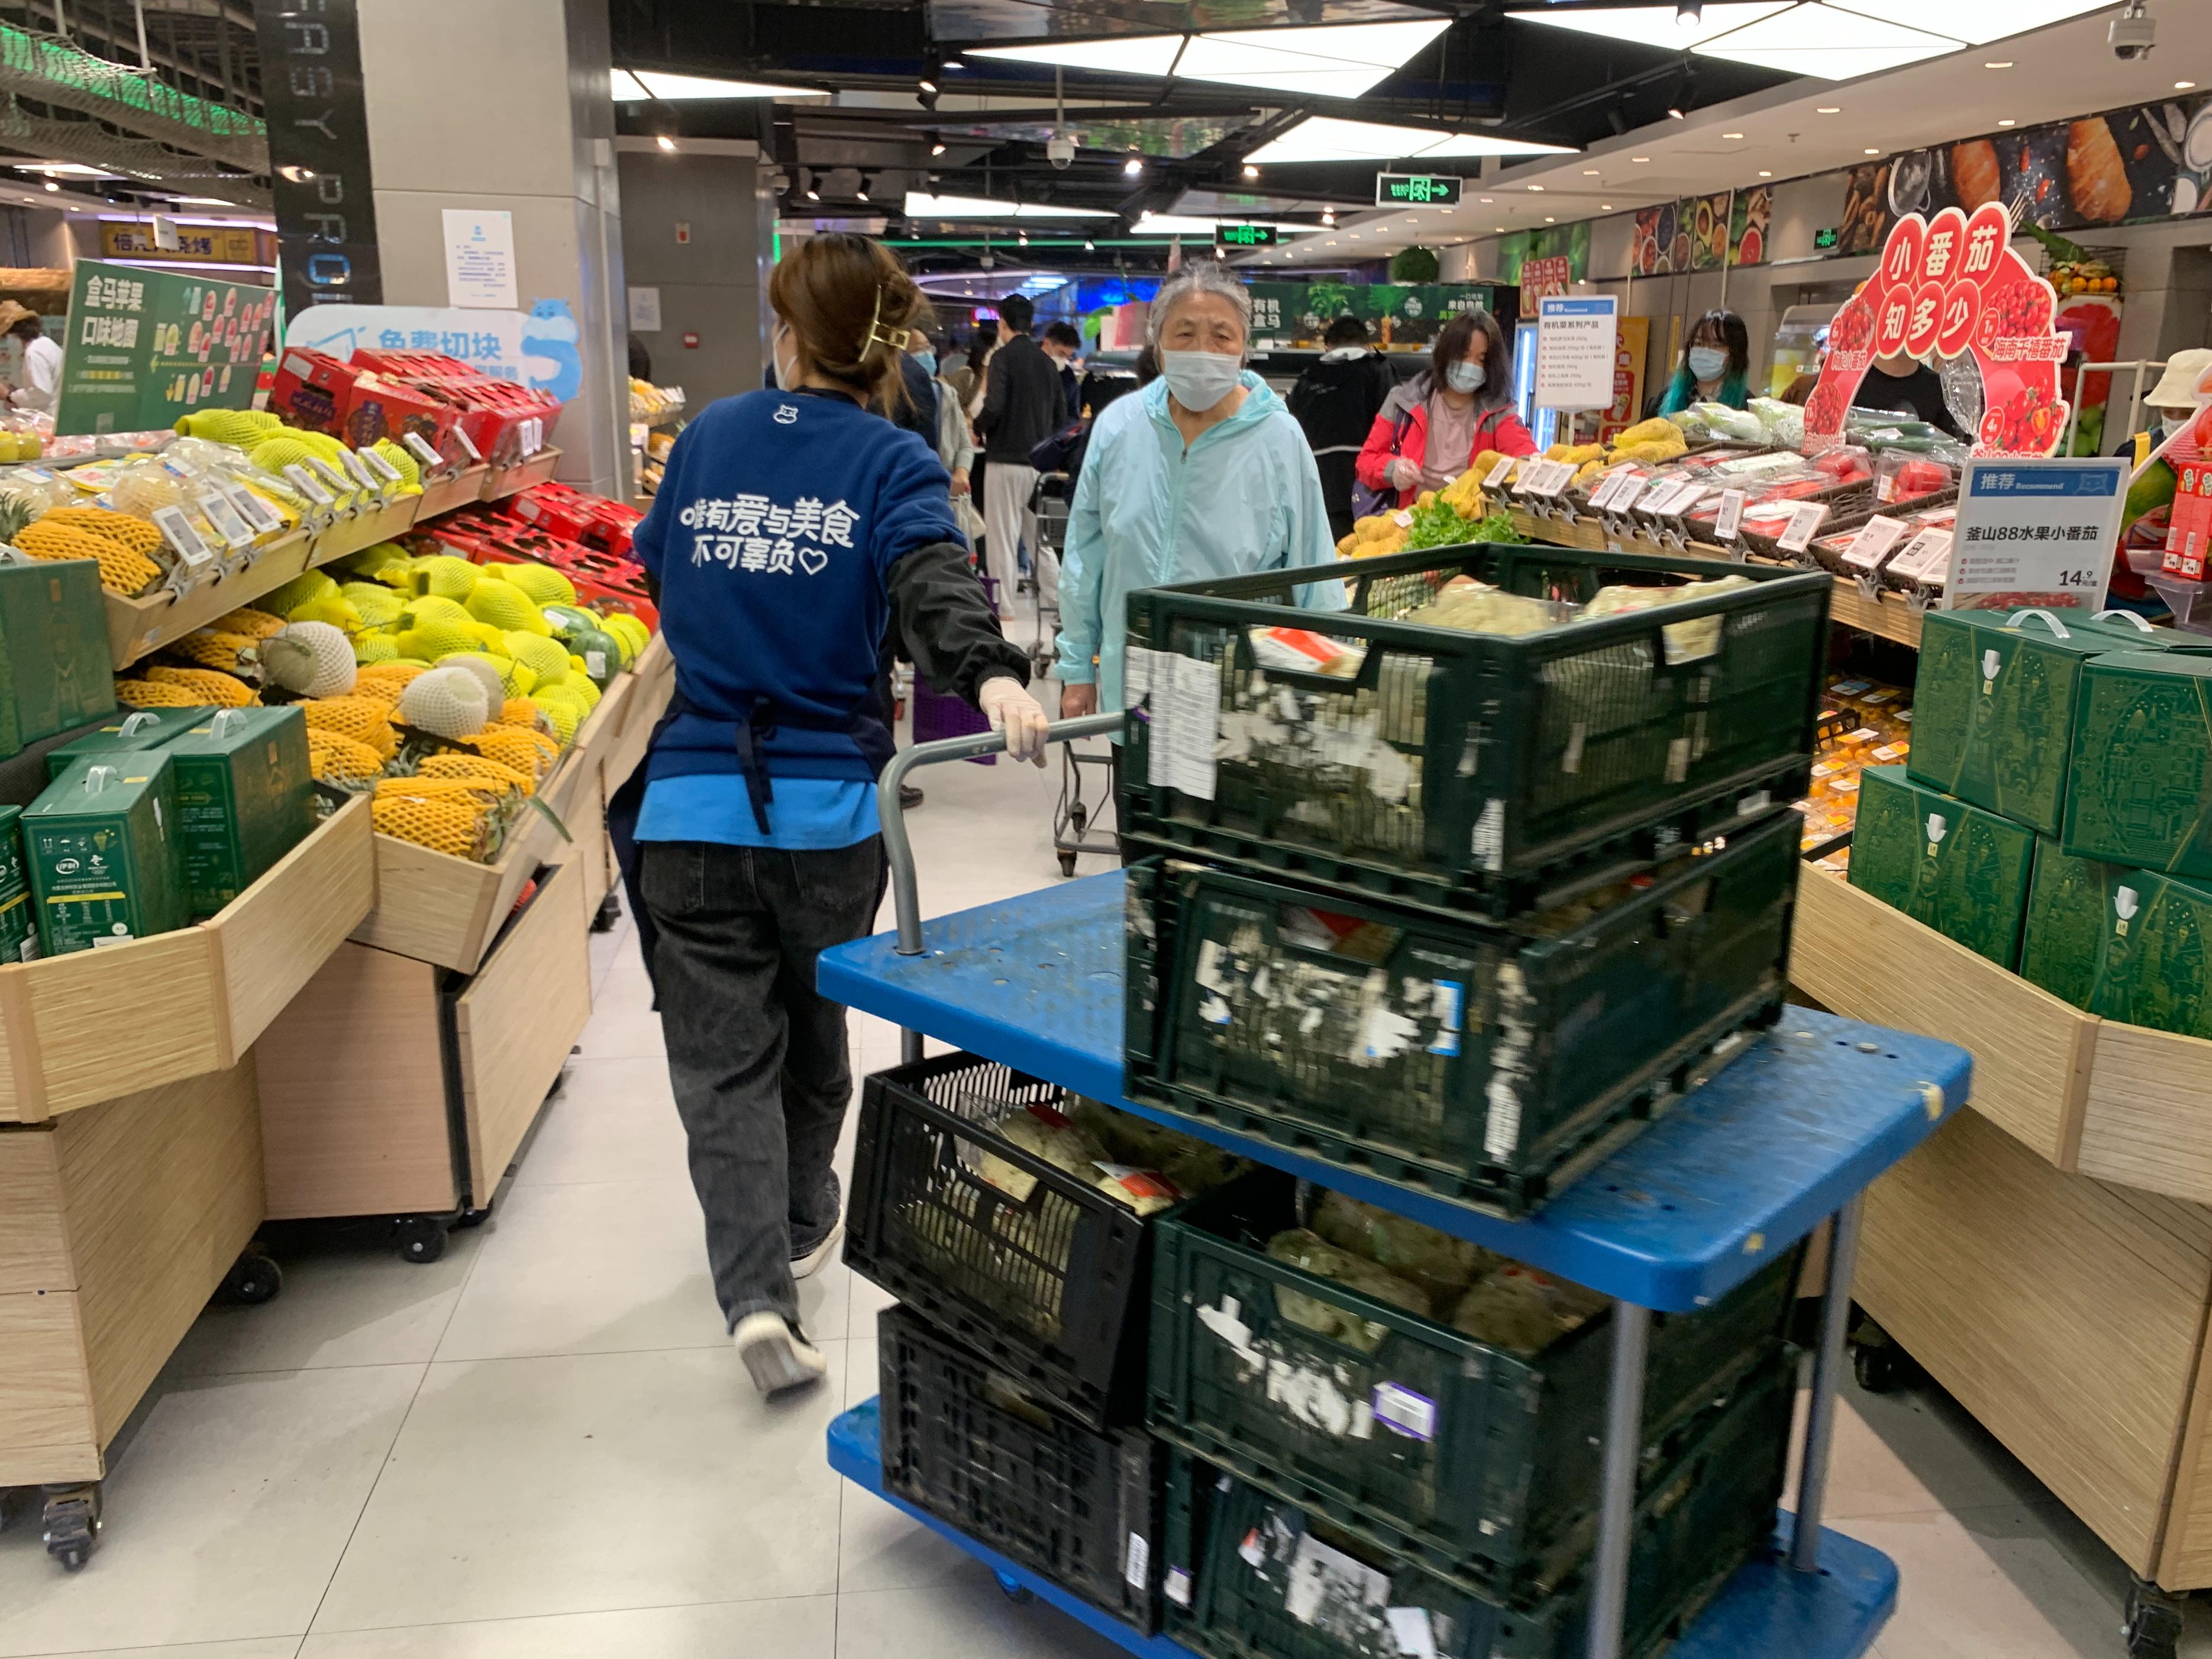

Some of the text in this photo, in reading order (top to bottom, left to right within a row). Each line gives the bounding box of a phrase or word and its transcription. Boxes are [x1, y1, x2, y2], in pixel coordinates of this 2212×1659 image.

[1889, 224, 1998, 280] 小番茄
[85, 275, 144, 312] 盒马苹果
[82, 317, 138, 348] 口味地图
[1882, 297, 1969, 341] 知多少
[1981, 473, 2015, 490] 推荐
[680, 493, 860, 548] 唯有爱与美食
[1966, 526, 2098, 541] 釜山88水果小番茄
[692, 535, 795, 575] 不可辜负
